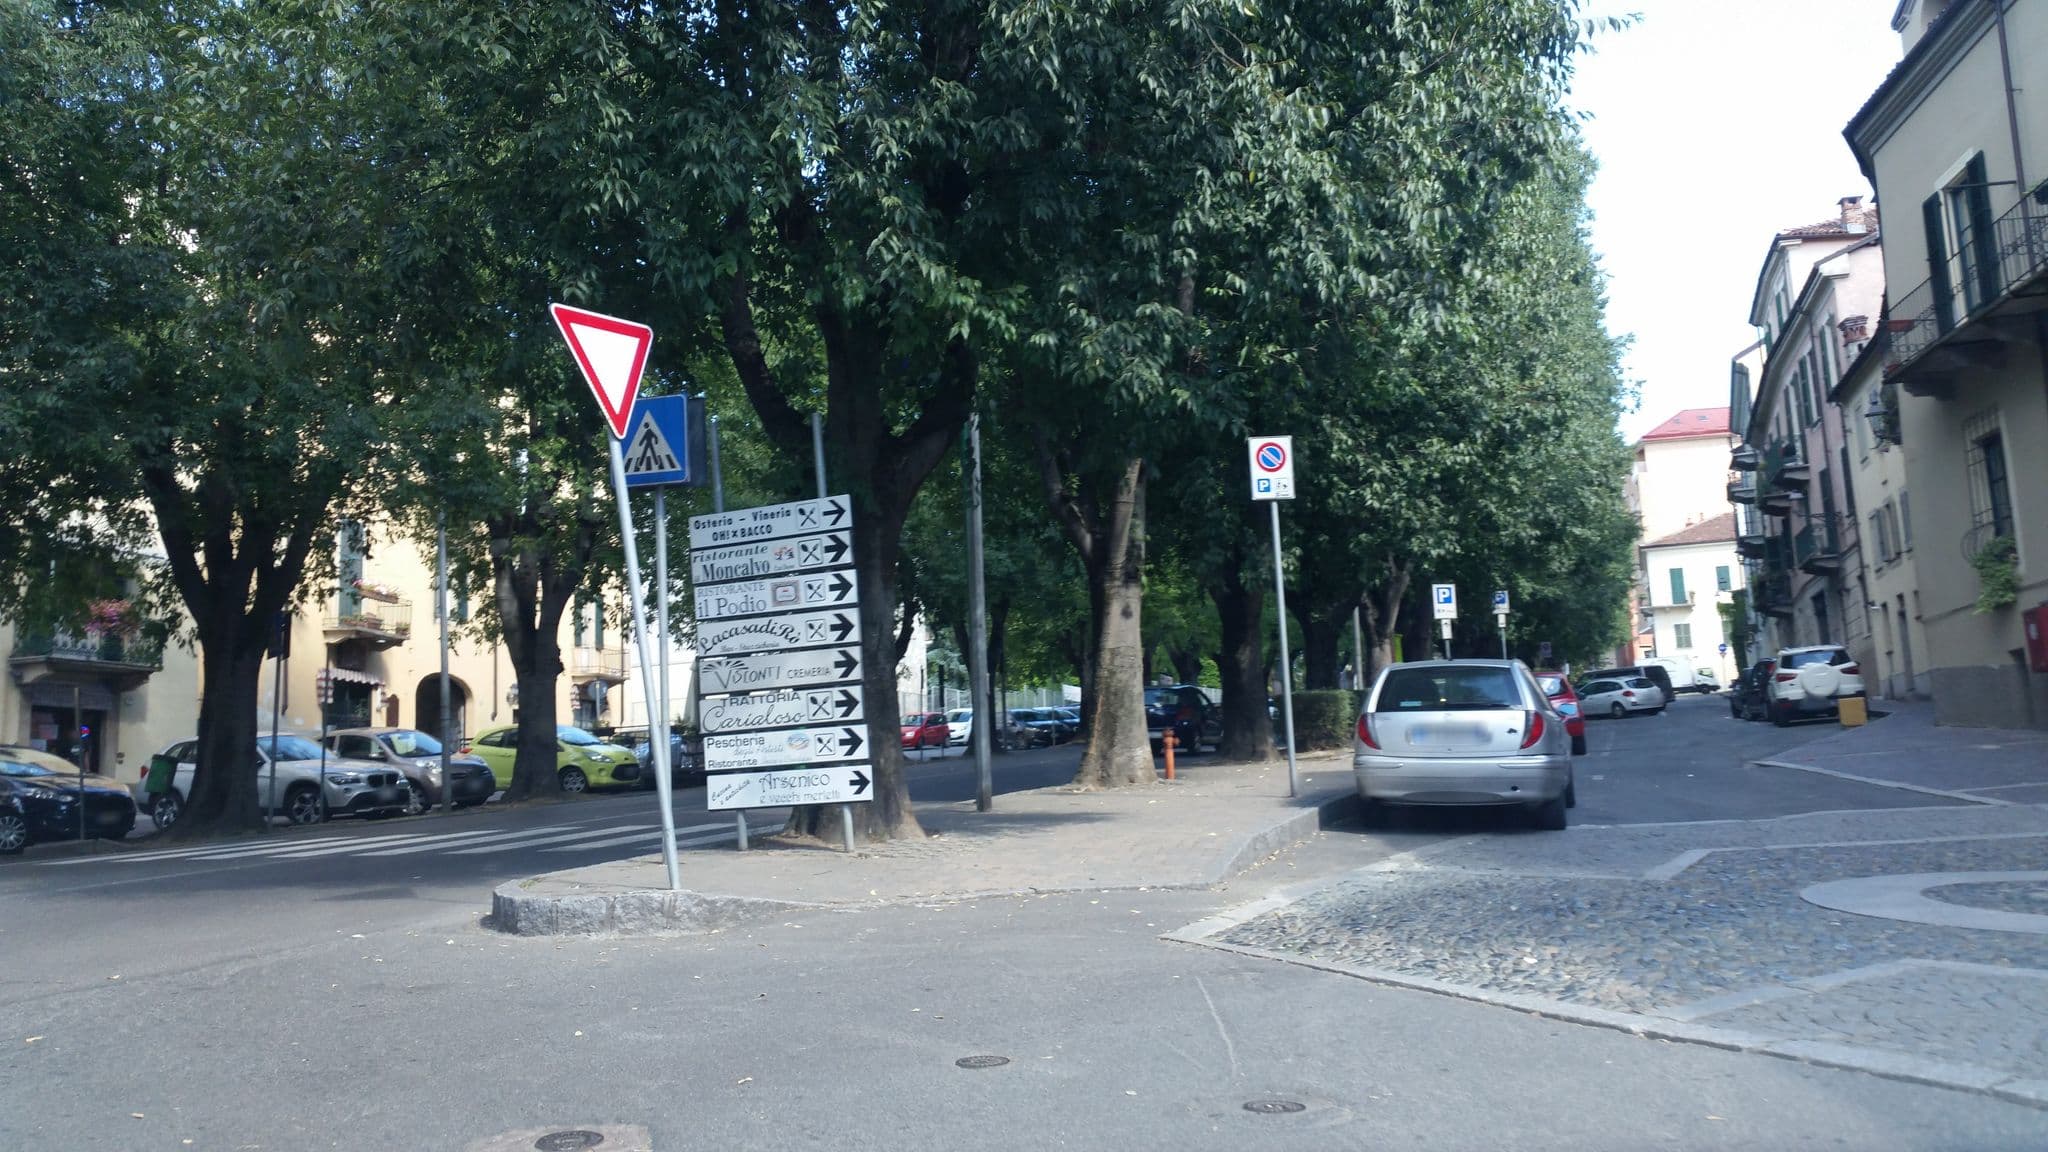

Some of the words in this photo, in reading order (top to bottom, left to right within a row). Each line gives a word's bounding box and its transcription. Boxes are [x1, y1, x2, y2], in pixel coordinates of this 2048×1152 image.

[1260, 480, 1269, 491] P
[694, 515, 733, 530] Osteria
[752, 507, 792, 522] Vineria
[740, 524, 773, 538] BACCO
[693, 544, 768, 563] ristorante
[702, 558, 770, 581] Moncalvo
[697, 582, 766, 598] RISTORANTE
[1439, 588, 1450, 603] P
[698, 599, 710, 618] il
[717, 594, 767, 616] Podio
[787, 668, 832, 679] CREMERIA
[720, 691, 800, 708] TRATTORIA
[706, 735, 766, 749] Pescheria
[708, 758, 758, 769] Ristorante
[759, 773, 831, 793] Arsenico
